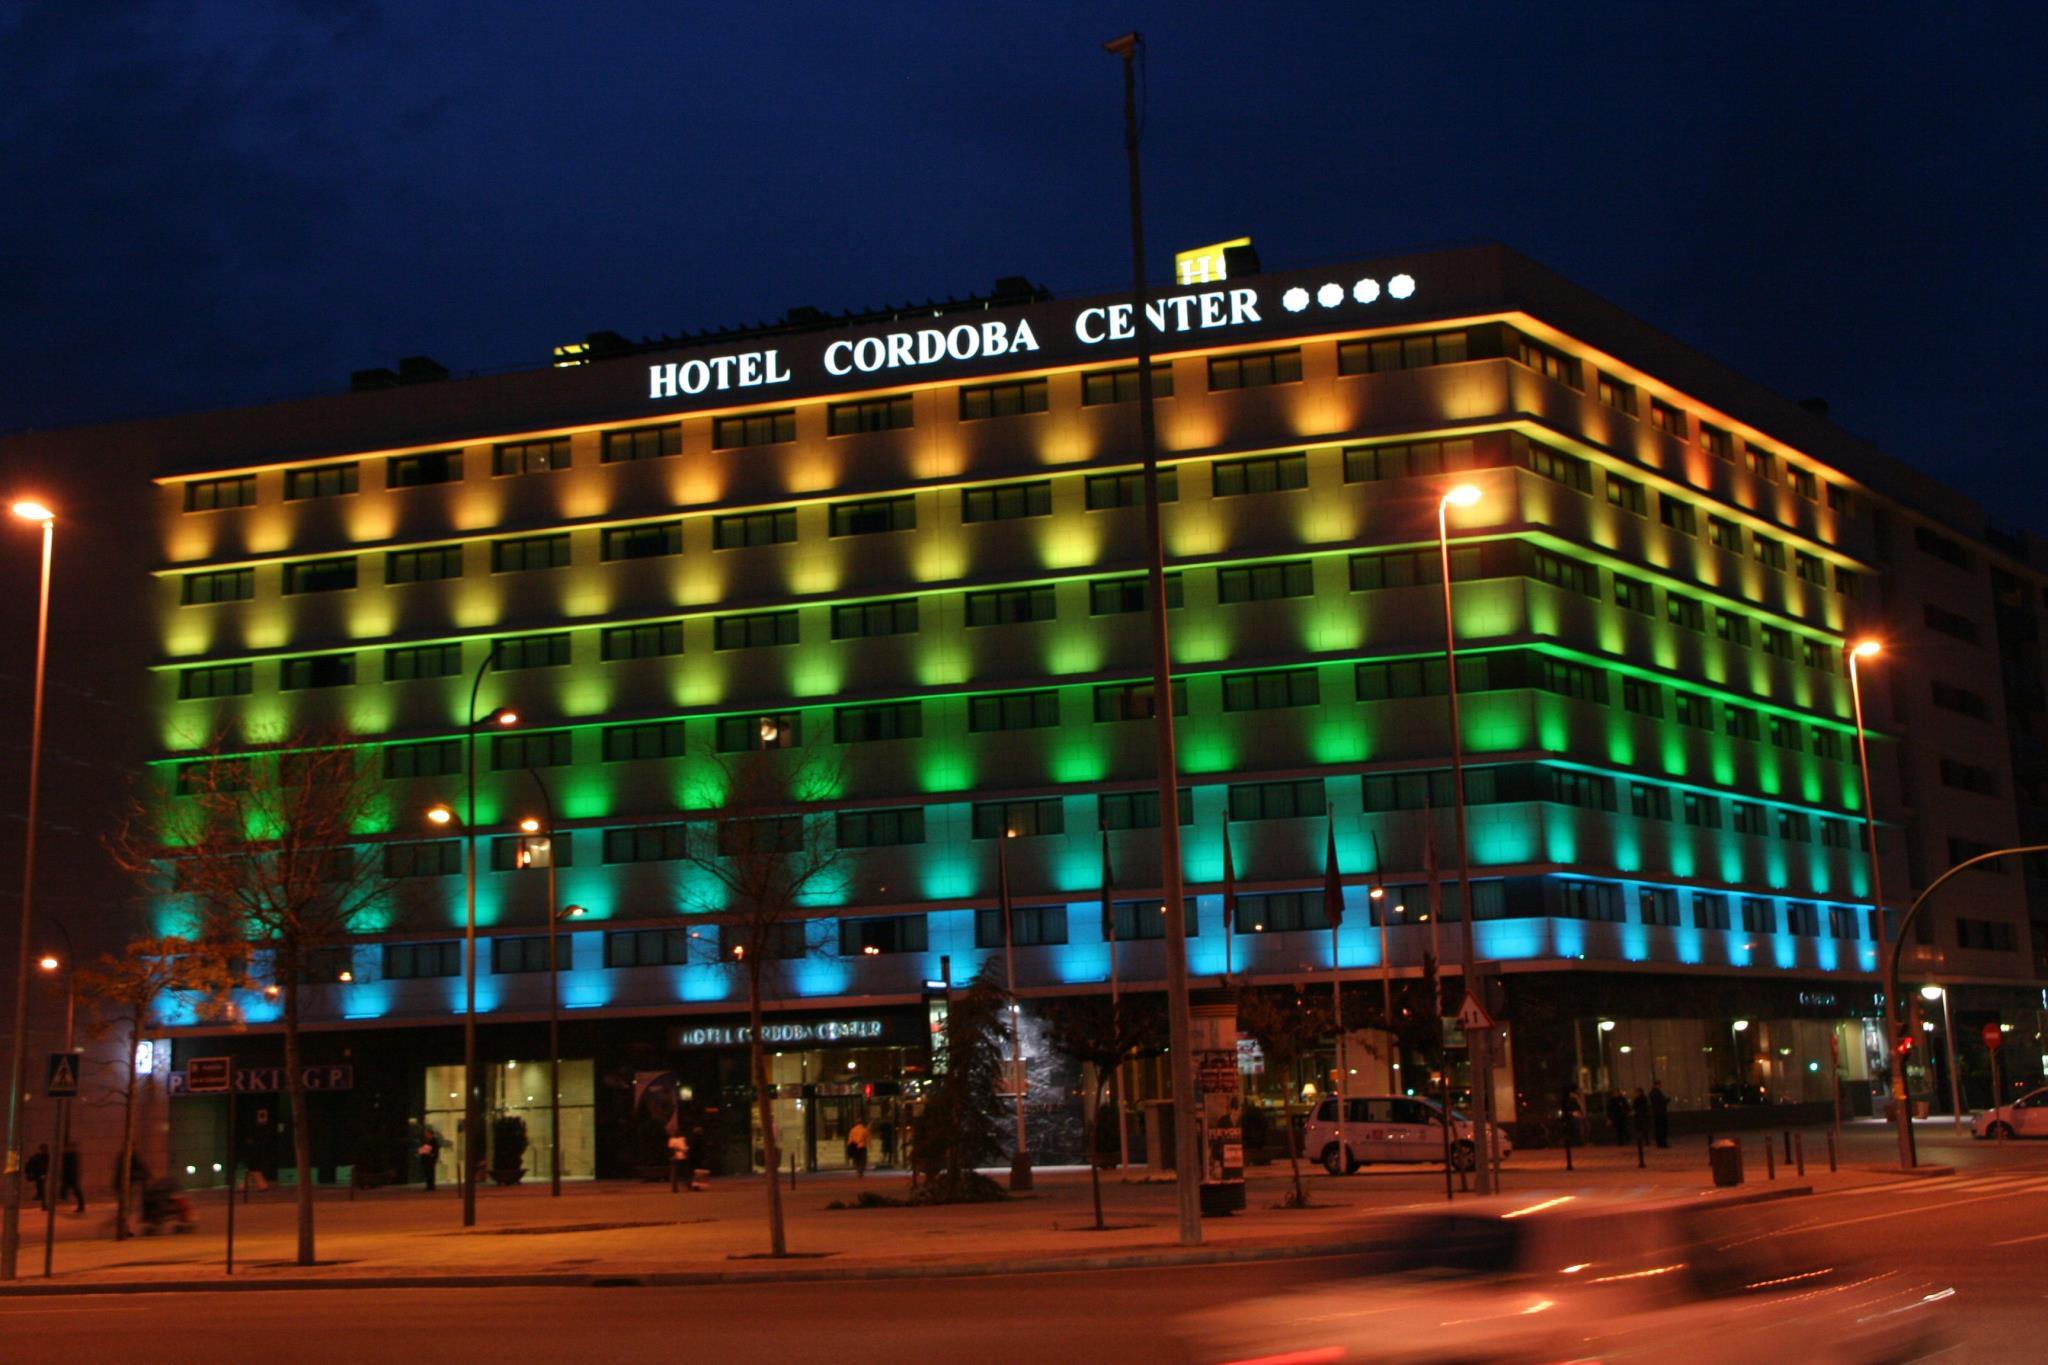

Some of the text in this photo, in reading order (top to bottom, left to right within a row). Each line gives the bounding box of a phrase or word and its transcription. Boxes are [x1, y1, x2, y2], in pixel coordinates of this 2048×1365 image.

[649, 288, 1262, 399] HOTEL CORDOBA CENTER
[736, 1024, 812, 1042] CRDOBA
